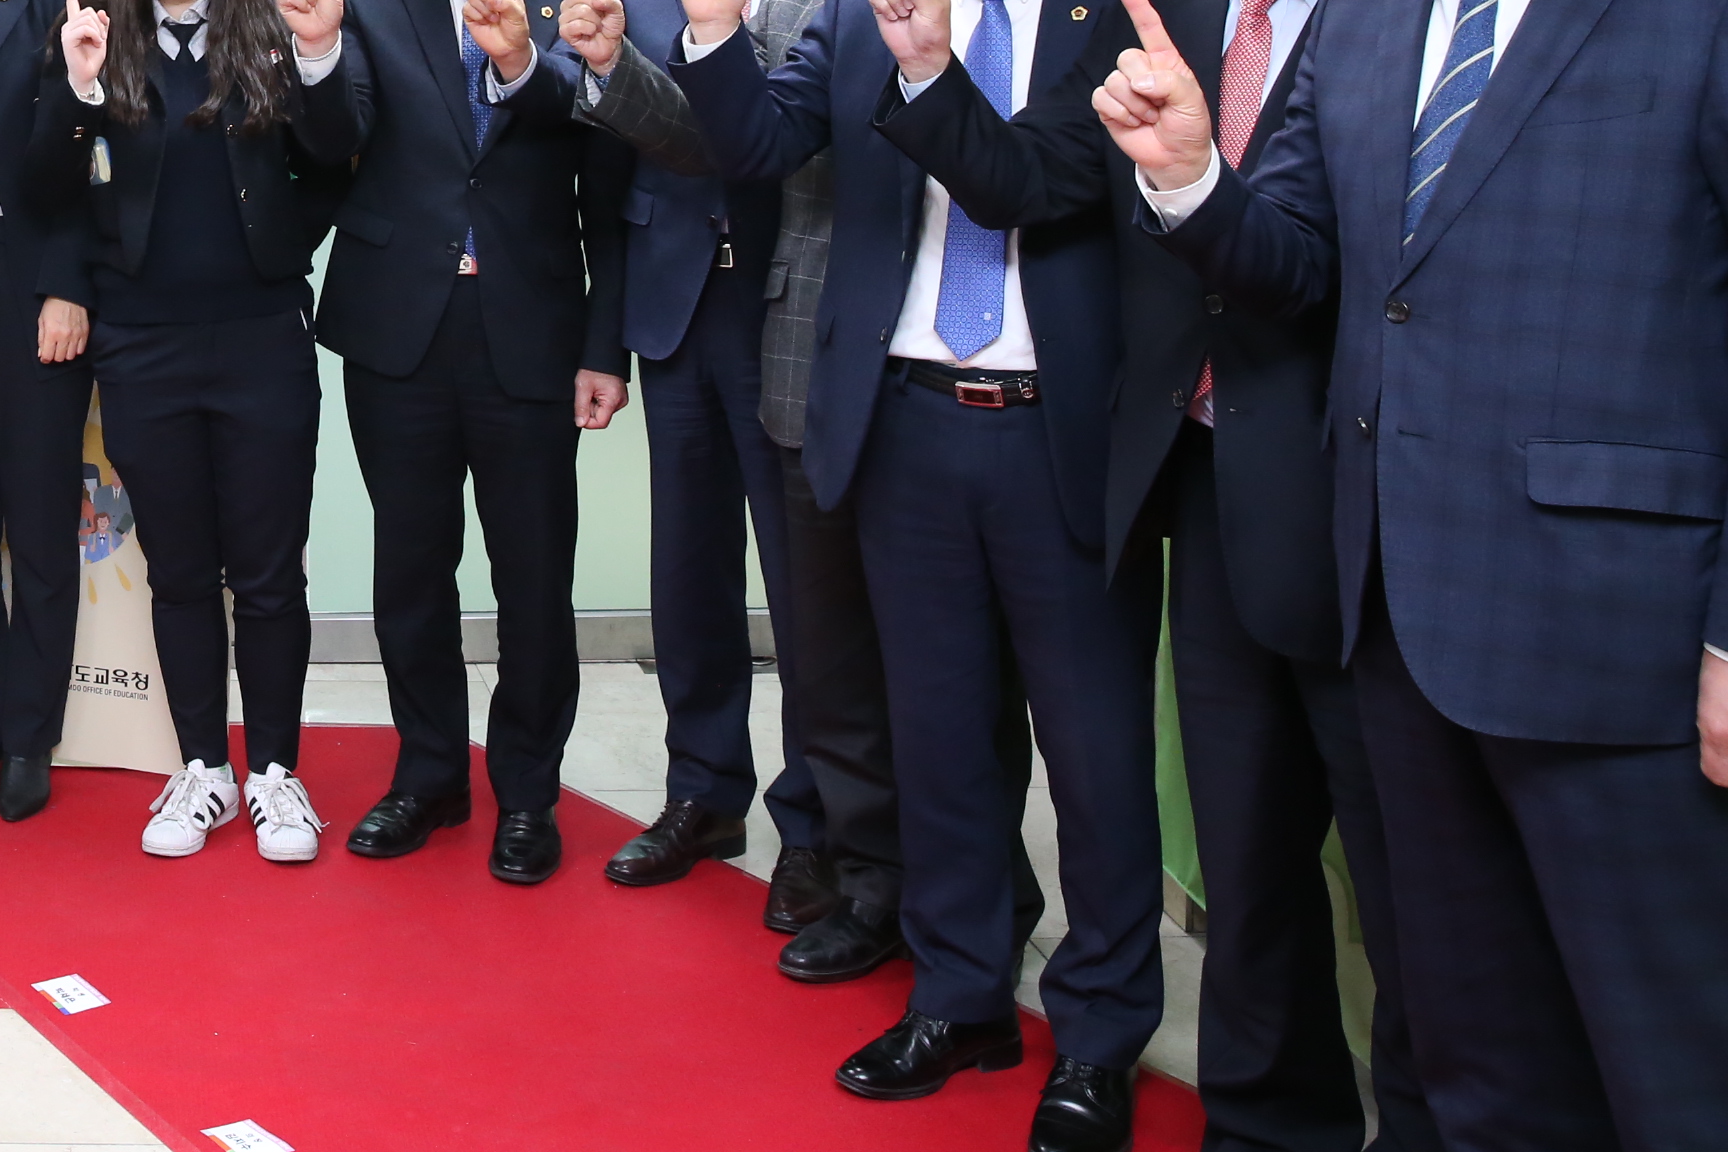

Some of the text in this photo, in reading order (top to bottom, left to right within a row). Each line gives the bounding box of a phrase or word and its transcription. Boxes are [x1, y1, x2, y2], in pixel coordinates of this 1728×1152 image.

[83, 685, 103, 695] OFFICE
[104, 688, 113, 696] OF
[113, 689, 149, 701] EDUCATION
